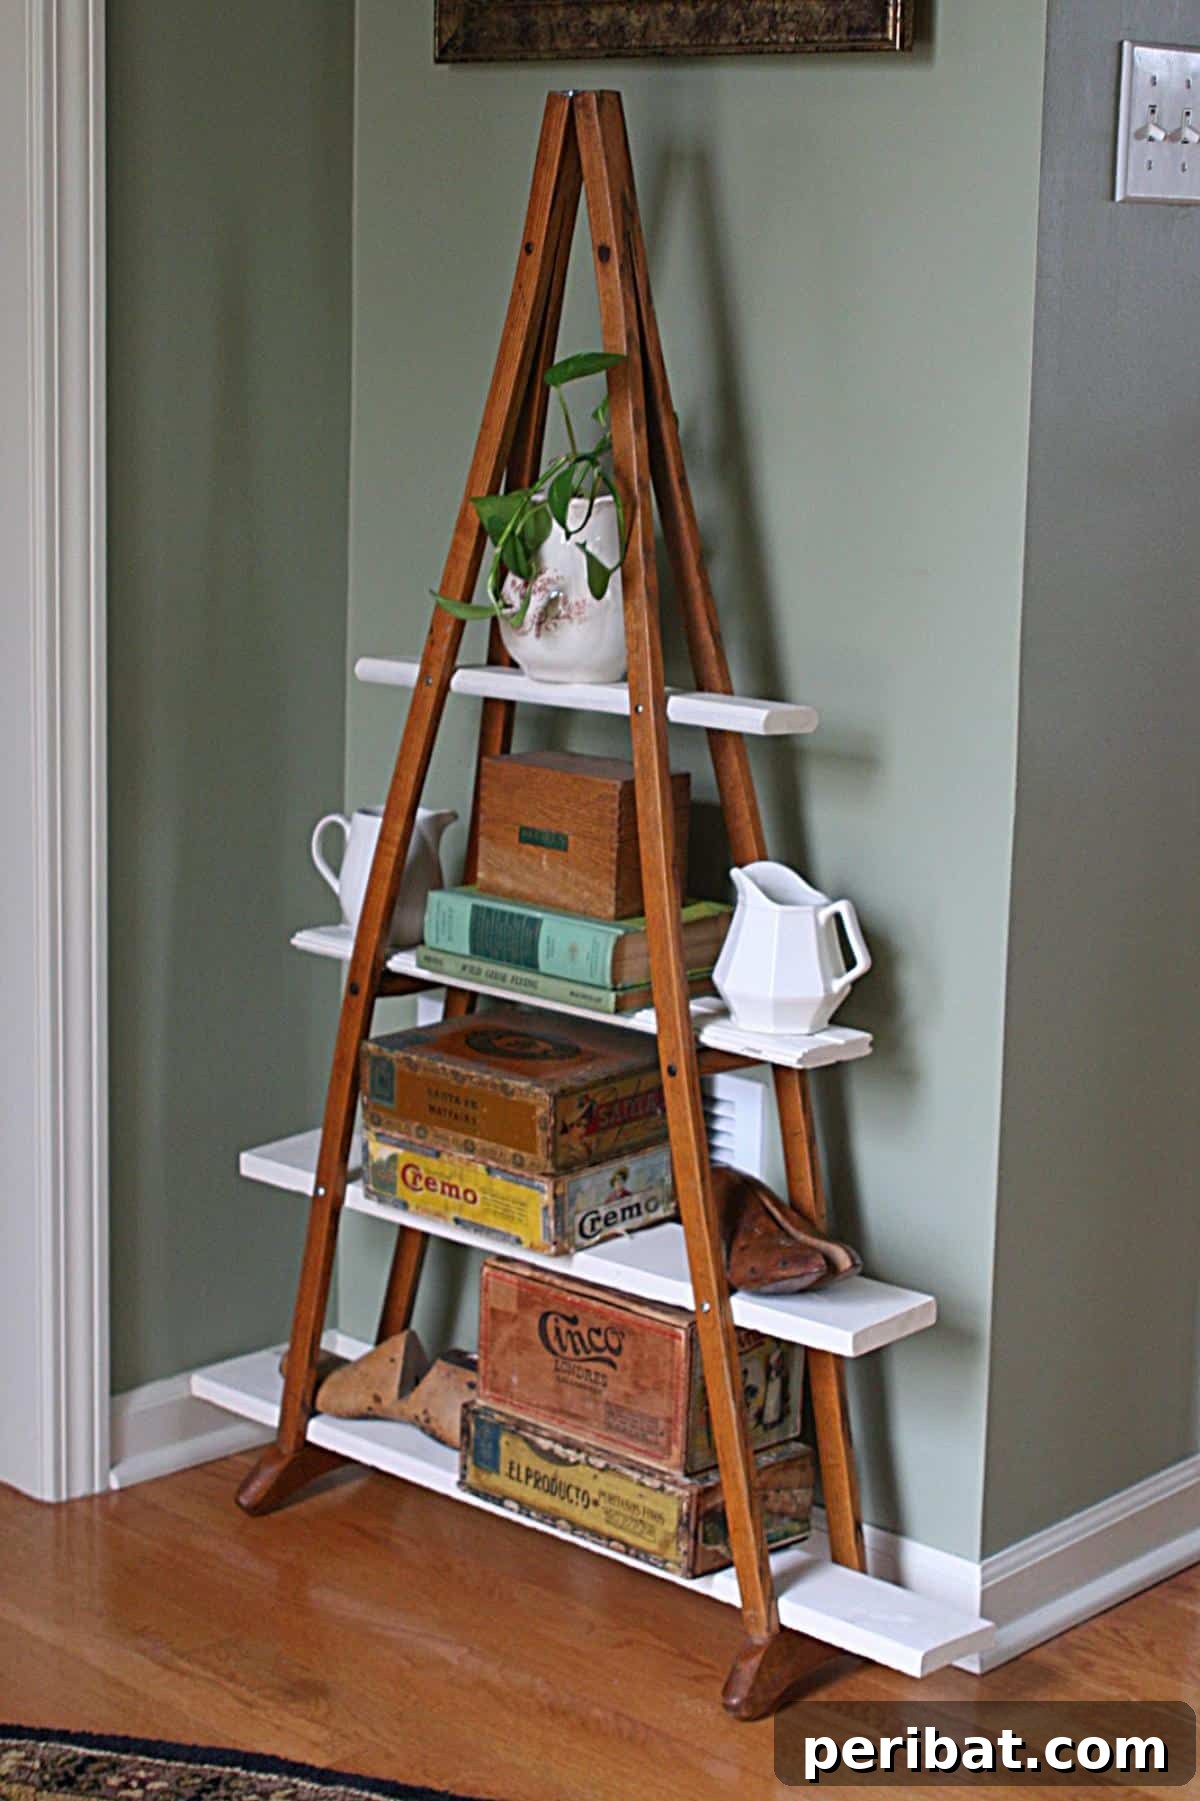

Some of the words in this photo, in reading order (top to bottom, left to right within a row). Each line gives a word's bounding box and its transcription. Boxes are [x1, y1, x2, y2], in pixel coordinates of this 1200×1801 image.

[401, 1163, 478, 1206] Cremo
[579, 1196, 660, 1239] Cremo
[538, 1310, 624, 1371] Cinco
[507, 1460, 523, 1483] EL
[524, 1466, 592, 1510] PRODUCTO
